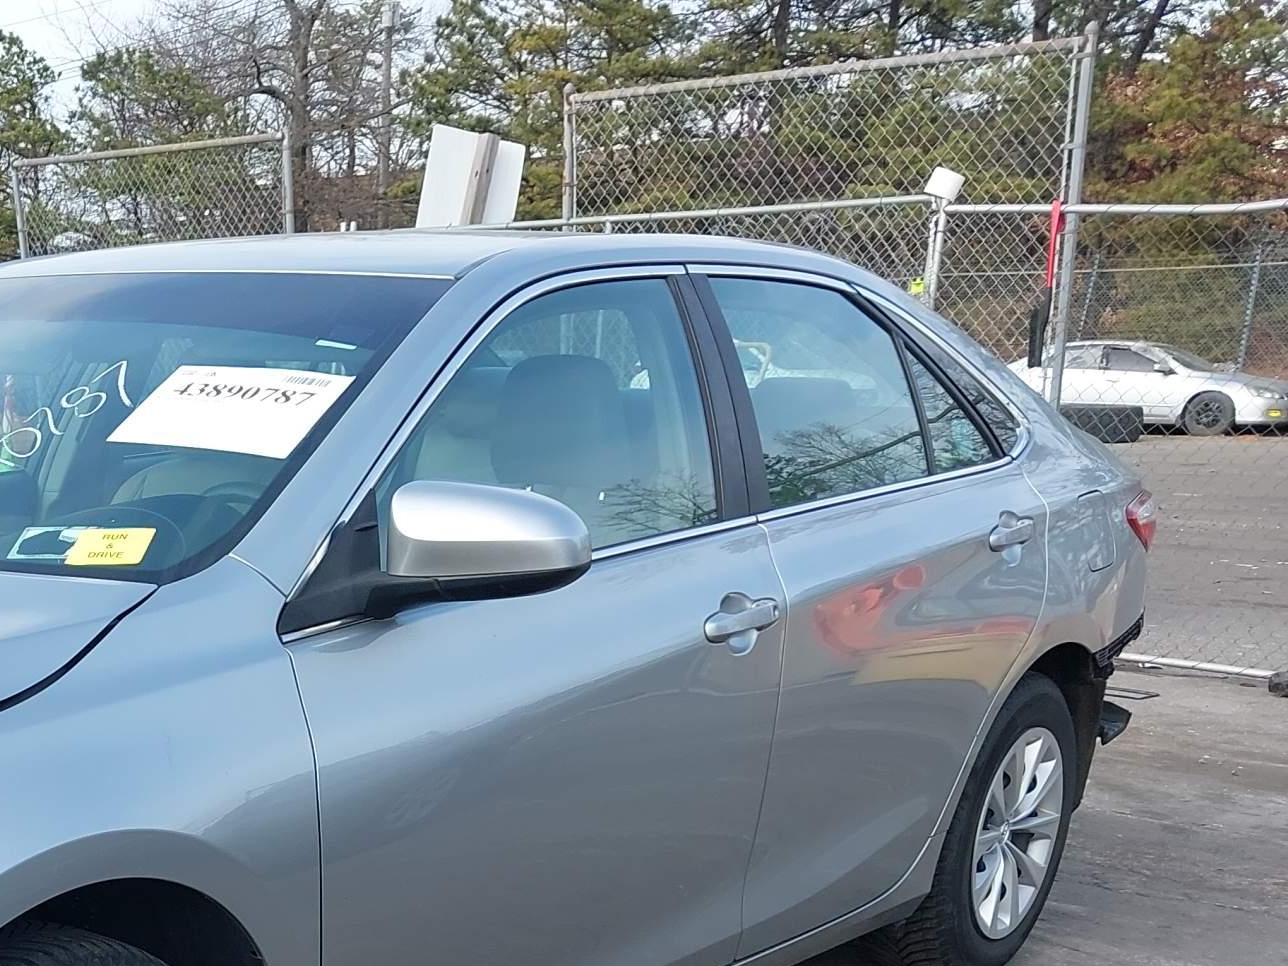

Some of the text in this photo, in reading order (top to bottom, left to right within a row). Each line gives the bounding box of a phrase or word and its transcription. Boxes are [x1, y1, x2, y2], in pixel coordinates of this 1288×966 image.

[173, 382, 317, 406] 43890787
[101, 533, 129, 541] RUN
[105, 542, 114, 550] &
[87, 551, 125, 559] DRIVE
